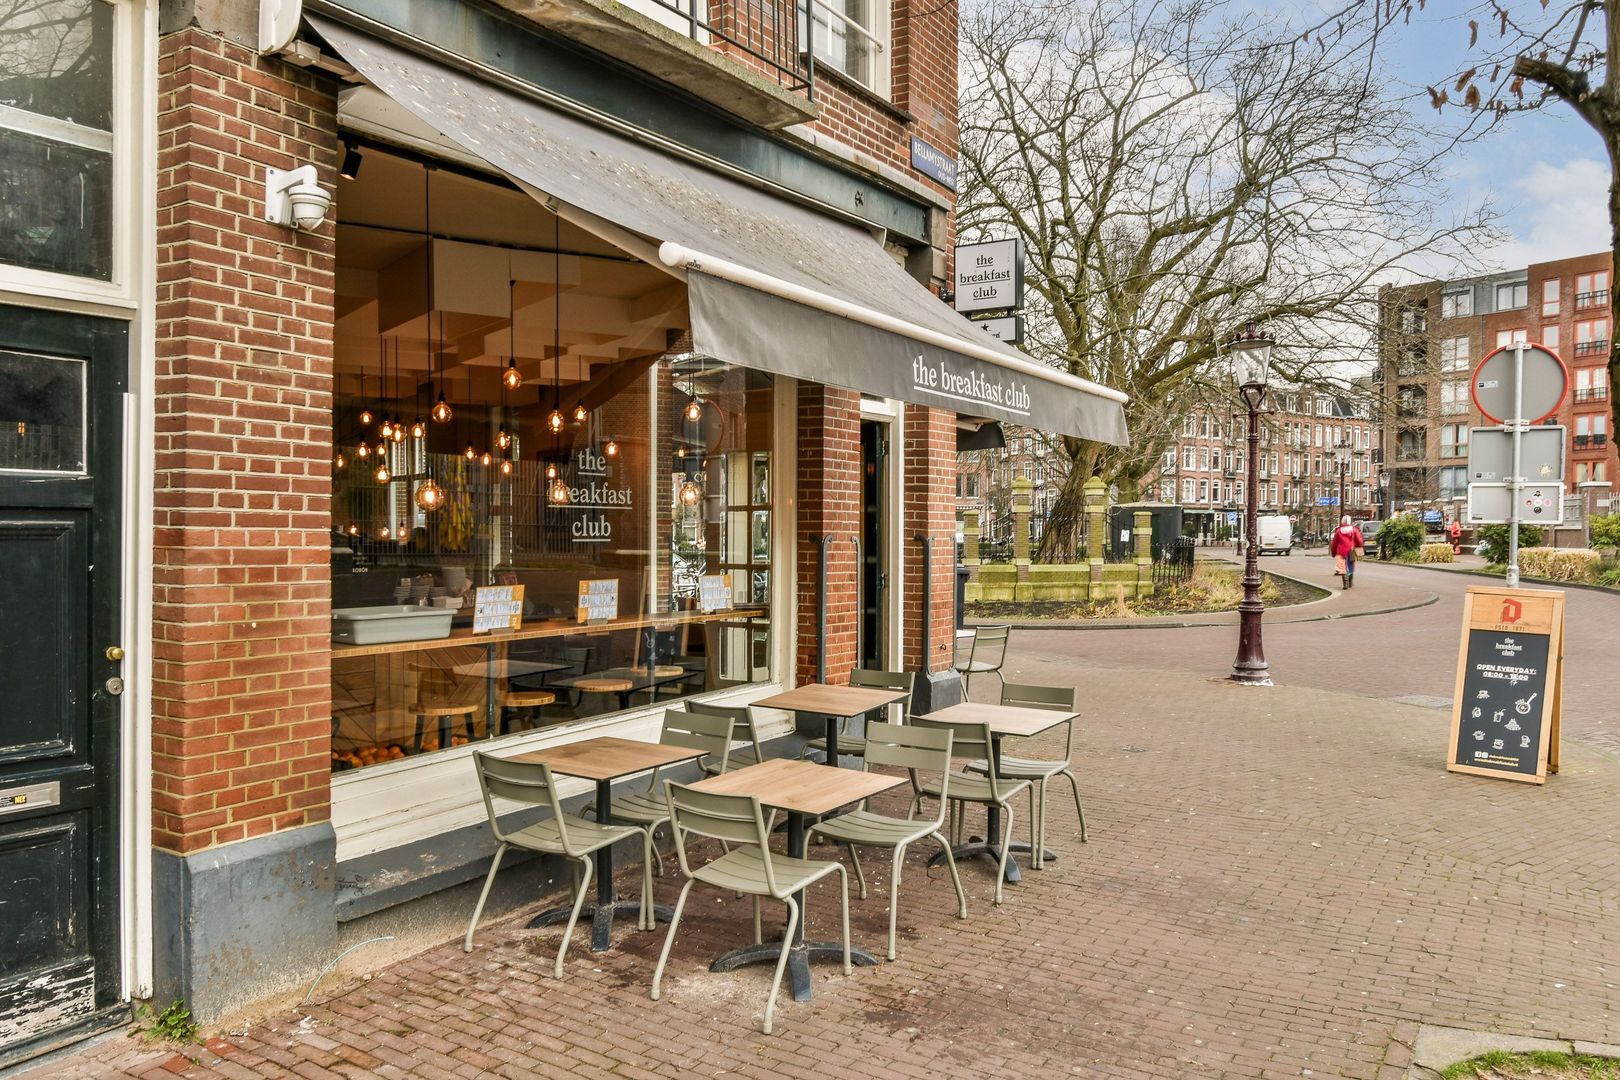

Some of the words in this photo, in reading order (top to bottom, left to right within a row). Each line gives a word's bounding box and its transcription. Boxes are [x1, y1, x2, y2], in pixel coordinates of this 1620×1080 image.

[914, 141, 954, 177] BELLAMYSTRAAT
[976, 255, 993, 265] the
[960, 270, 1010, 284] breakfast
[973, 286, 997, 298] club
[913, 355, 937, 387] the
[941, 362, 1002, 403] breakfast
[1005, 382, 1030, 409] club
[578, 448, 606, 470] the
[548, 480, 632, 504] beakfast
[572, 514, 611, 536] club
[1476, 663, 1496, 671] OPEN
